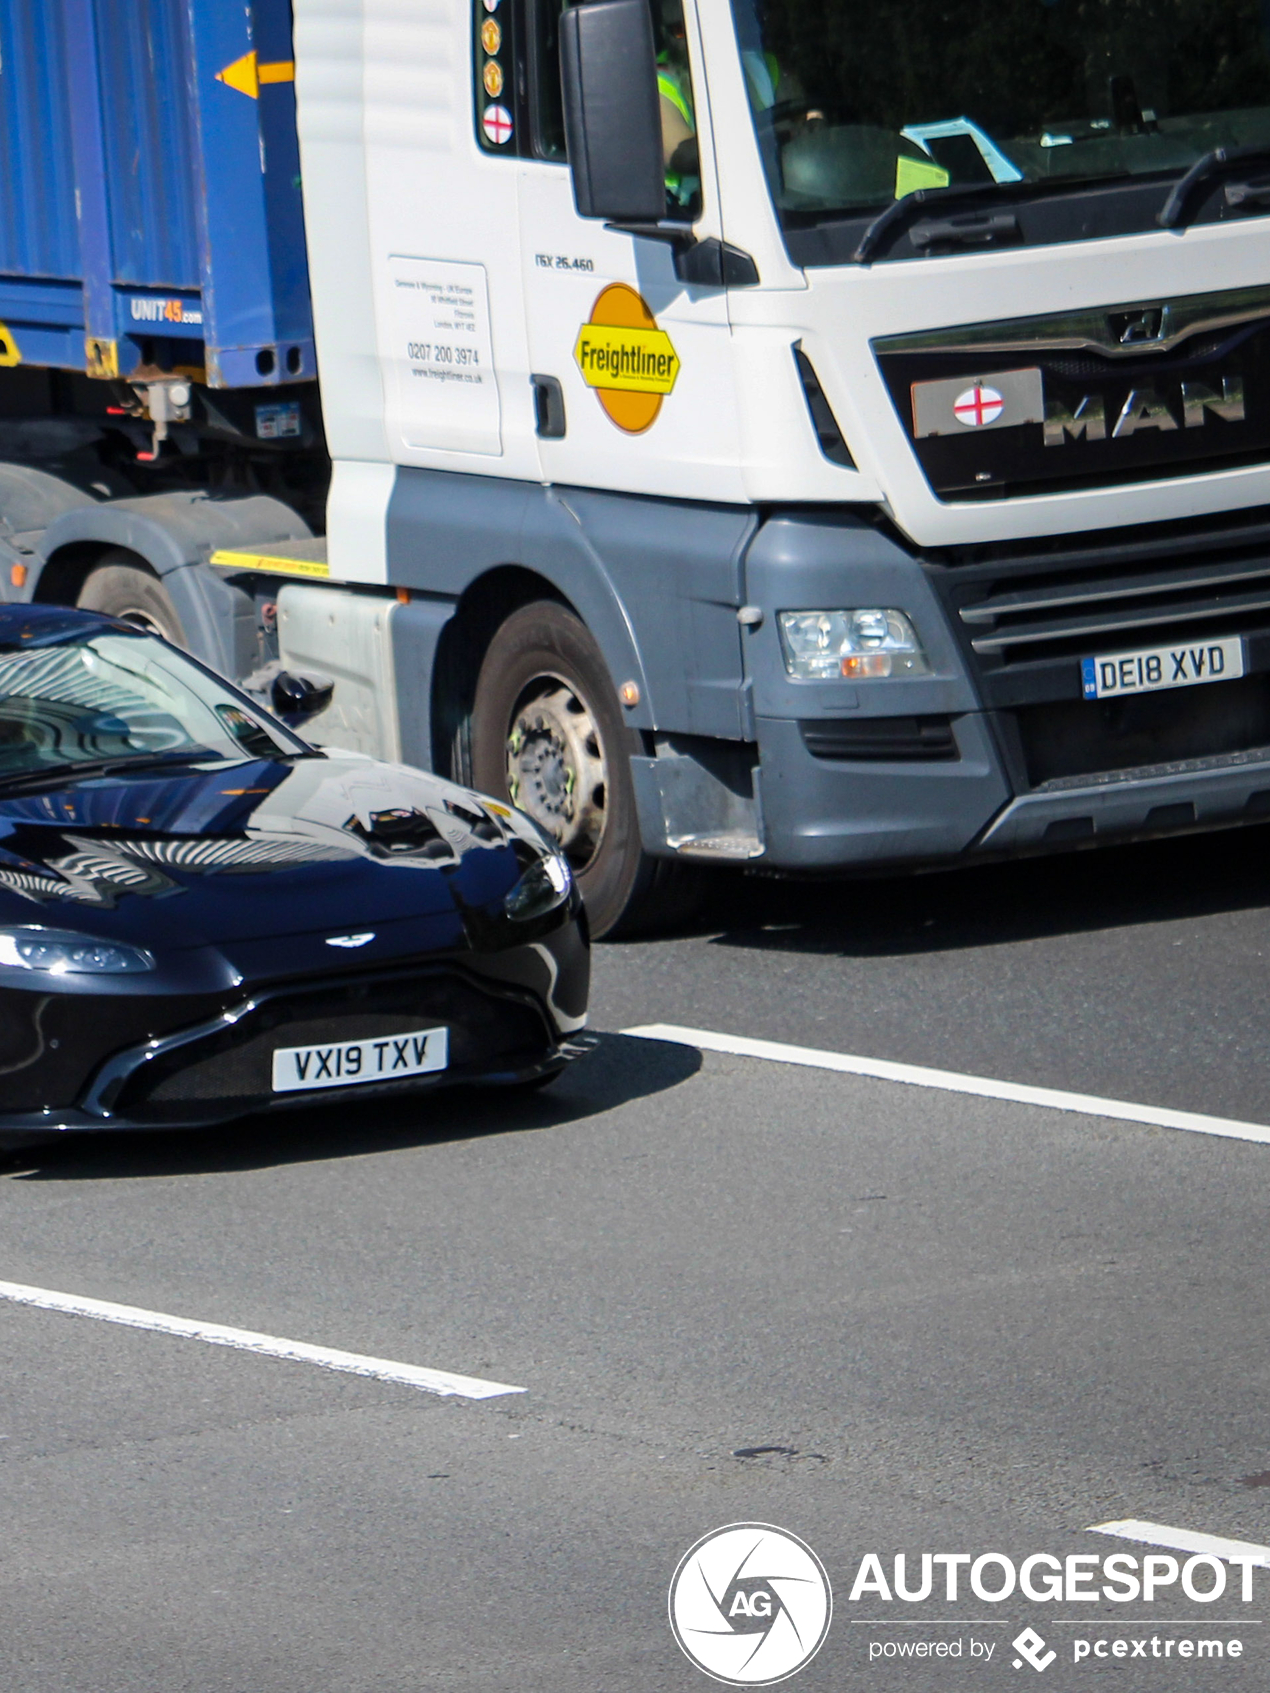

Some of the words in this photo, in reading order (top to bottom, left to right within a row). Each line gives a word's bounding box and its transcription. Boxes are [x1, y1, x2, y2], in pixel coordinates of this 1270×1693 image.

[408, 342, 431, 360] 0207
[435, 345, 452, 363] 200
[455, 348, 479, 366] 3974
[581, 341, 674, 378] Freightliner
[1043, 375, 1246, 447] MAN
[1099, 655, 1162, 692] DE18
[1170, 646, 1225, 681] XVD
[295, 1046, 362, 1081] VX19
[373, 1036, 428, 1072] TXV
